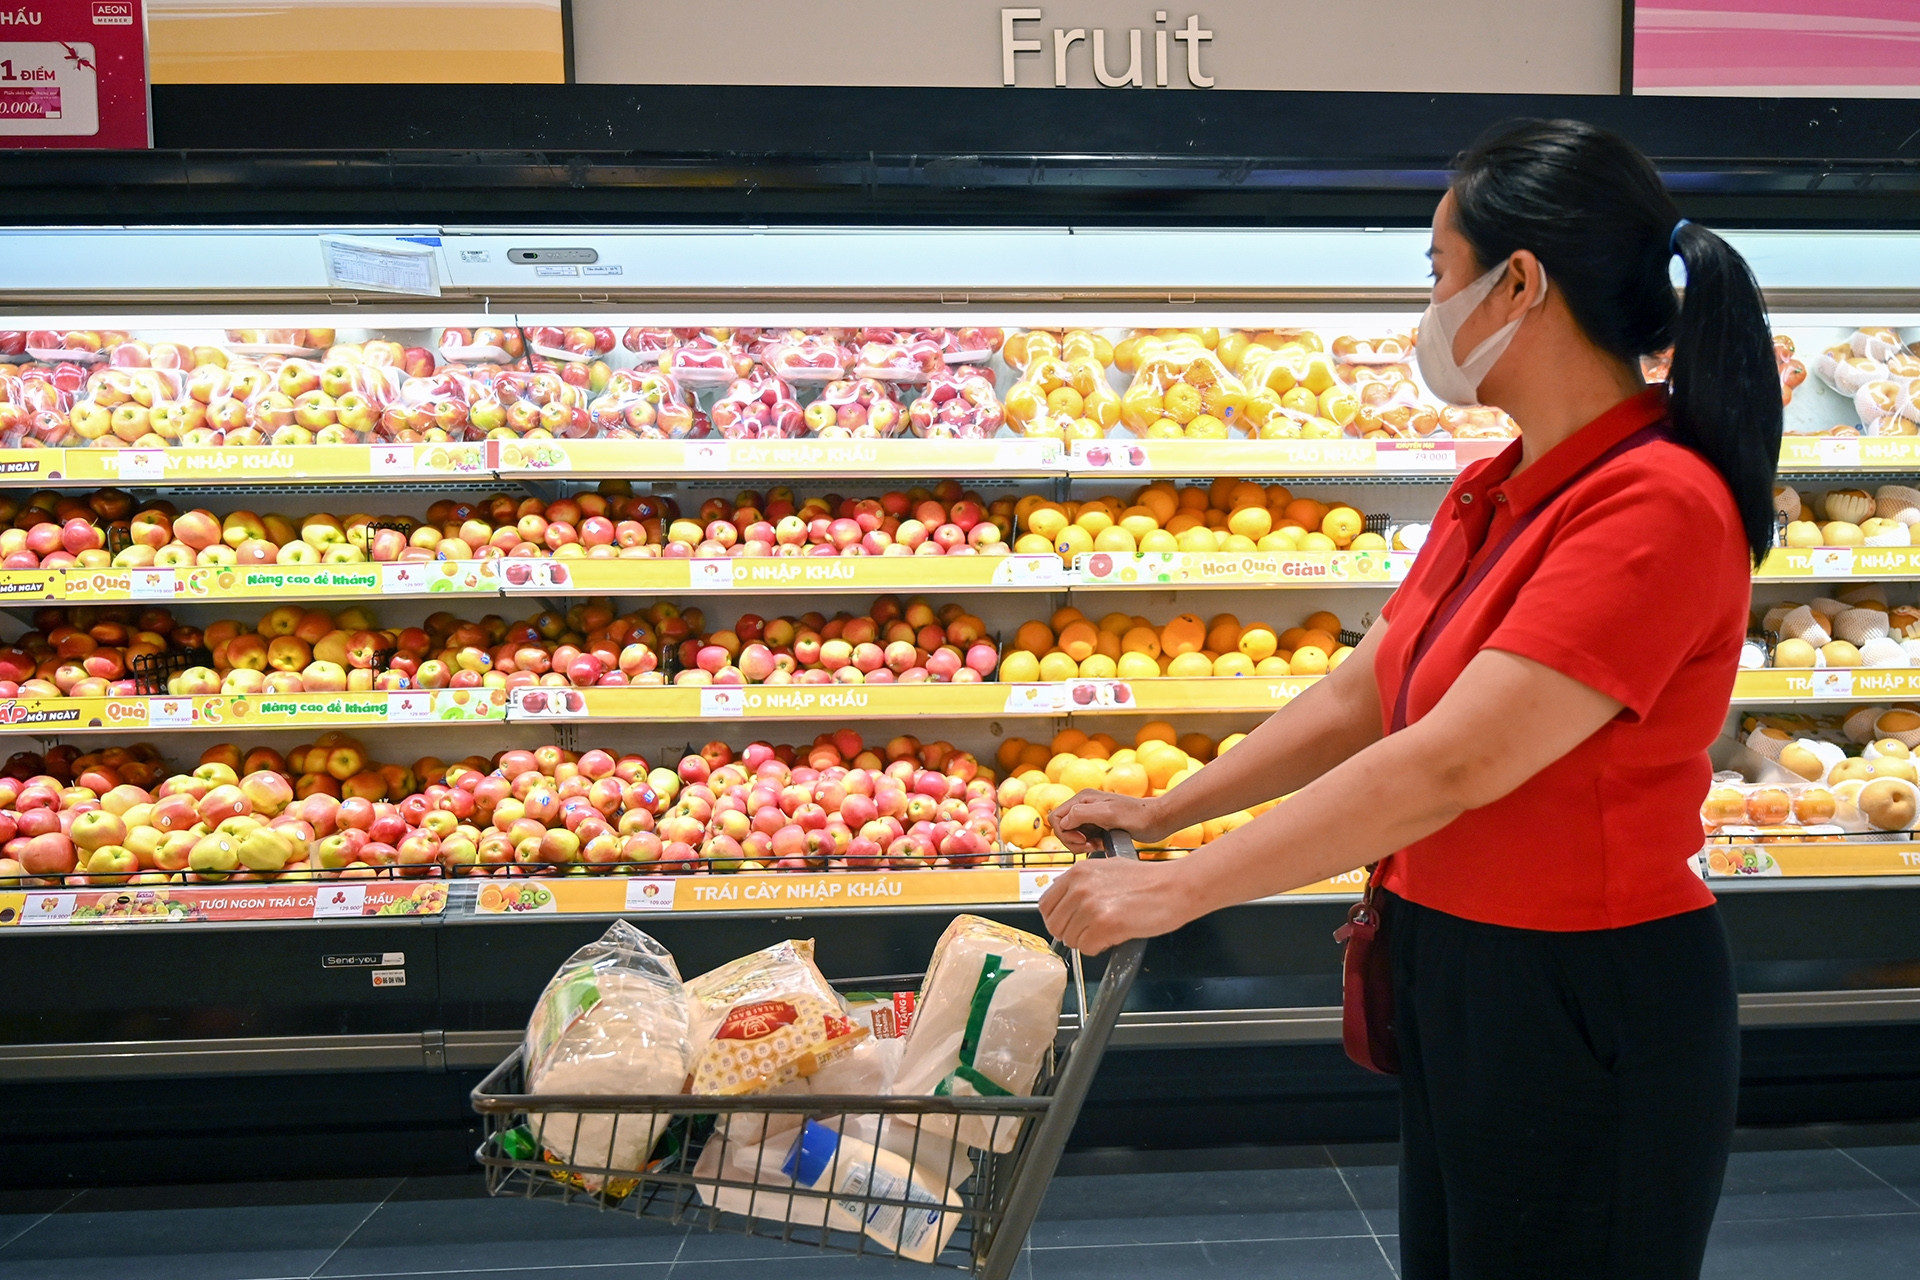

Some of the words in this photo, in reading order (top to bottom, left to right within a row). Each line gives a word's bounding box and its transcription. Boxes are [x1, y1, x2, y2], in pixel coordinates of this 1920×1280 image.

[97, 6, 127, 14] AEON
[1002, 8, 1215, 88] Fruit
[0, 60, 17, 80] 1
[20, 66, 56, 80] ĐIỂM
[8, 462, 37, 472] NGÀY
[186, 452, 239, 472] NHẬP
[1861, 552, 1906, 570] NHẬP
[752, 563, 802, 583] NHẬP
[1203, 563, 1237, 575] Hoa
[1282, 562, 1326, 576] Giàu
[19, 582, 42, 591] NGÀY
[287, 576, 310, 584] cao
[333, 574, 375, 587] kháng
[1860, 673, 1904, 692] NHẬP
[766, 691, 815, 710] NHẬP
[49, 711, 77, 720] NGÀY
[300, 704, 324, 712] cao
[345, 702, 388, 716] kháng
[693, 882, 738, 900] TRÁI
[744, 882, 782, 899] CÂY
[787, 880, 842, 901] NHẬP
[230, 899, 266, 908] NGON
[269, 896, 295, 907] TRÁI
[327, 955, 377, 965] Send-you
